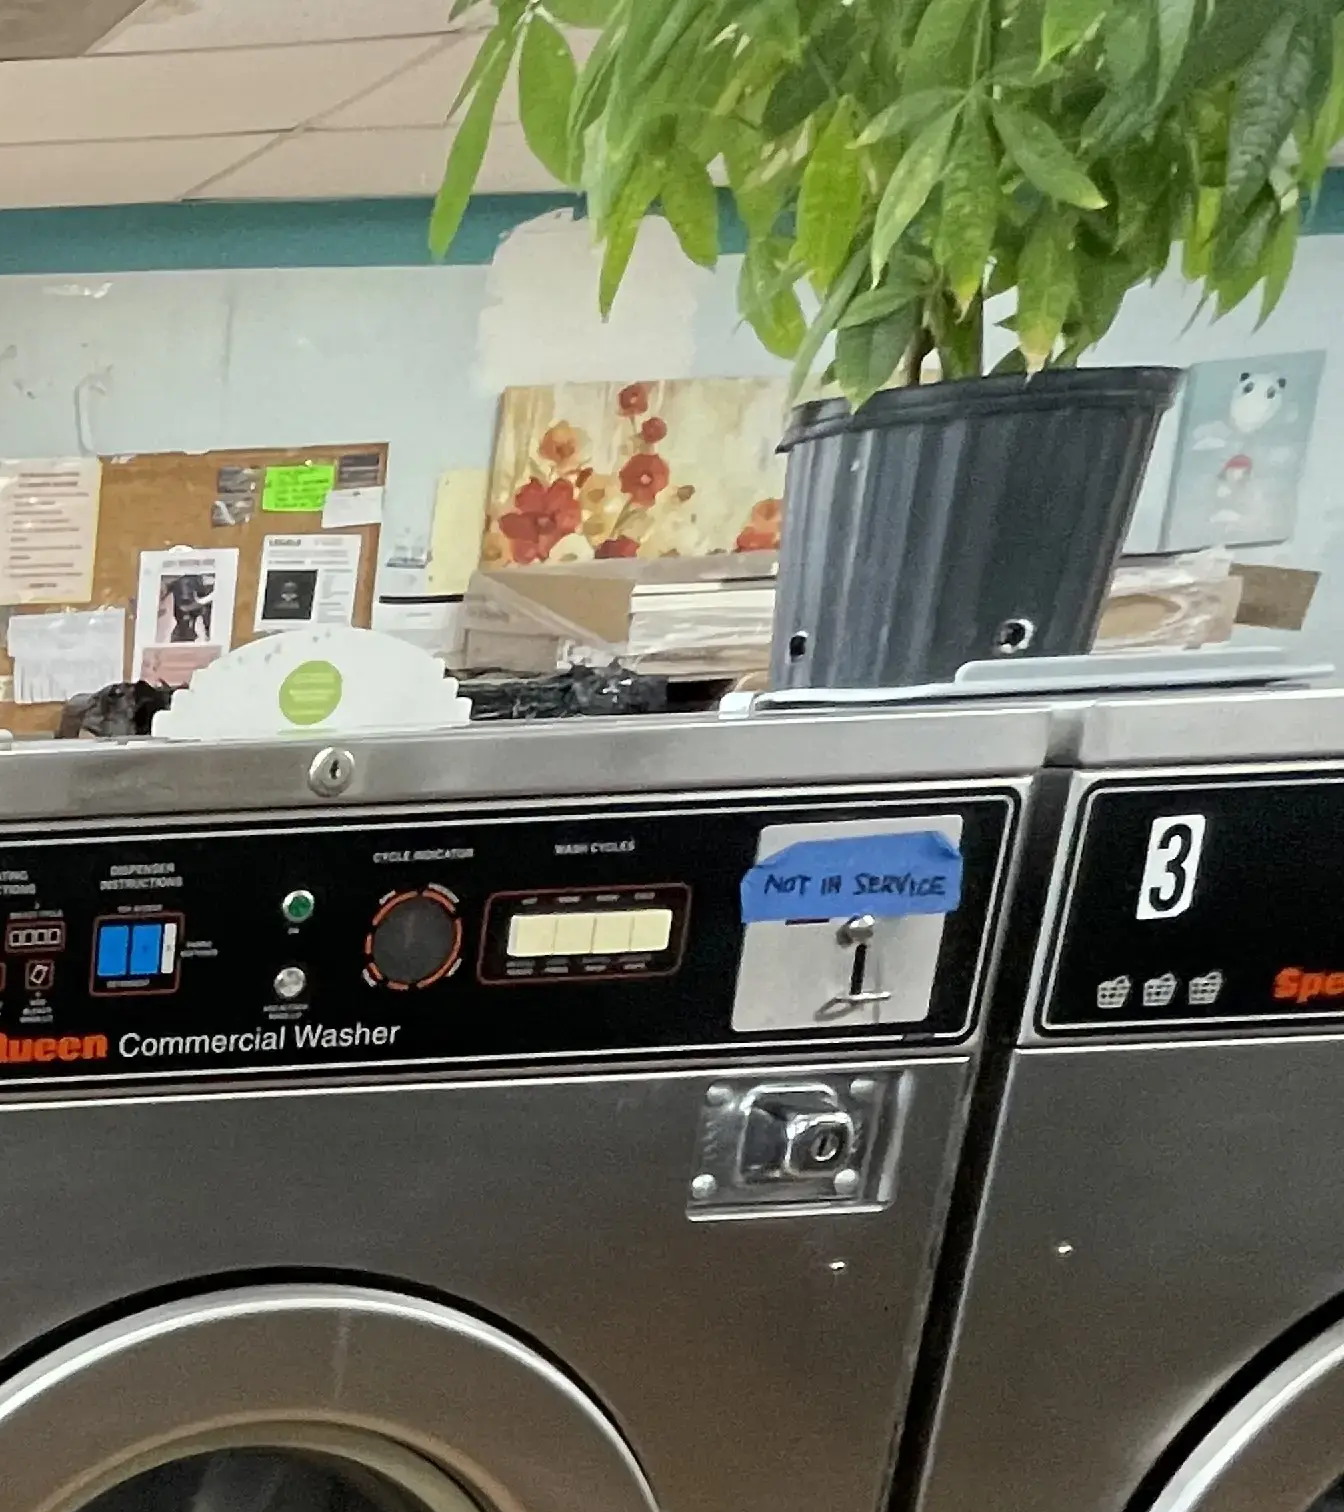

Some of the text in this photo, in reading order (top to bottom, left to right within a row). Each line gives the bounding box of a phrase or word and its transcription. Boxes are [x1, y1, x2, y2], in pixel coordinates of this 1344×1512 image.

[764, 874, 812, 895] NOT
[852, 872, 948, 896] SERVICE
[1148, 823, 1192, 912] 3
[118, 1025, 286, 1058] Commercial
[293, 1020, 400, 1049] Washer
